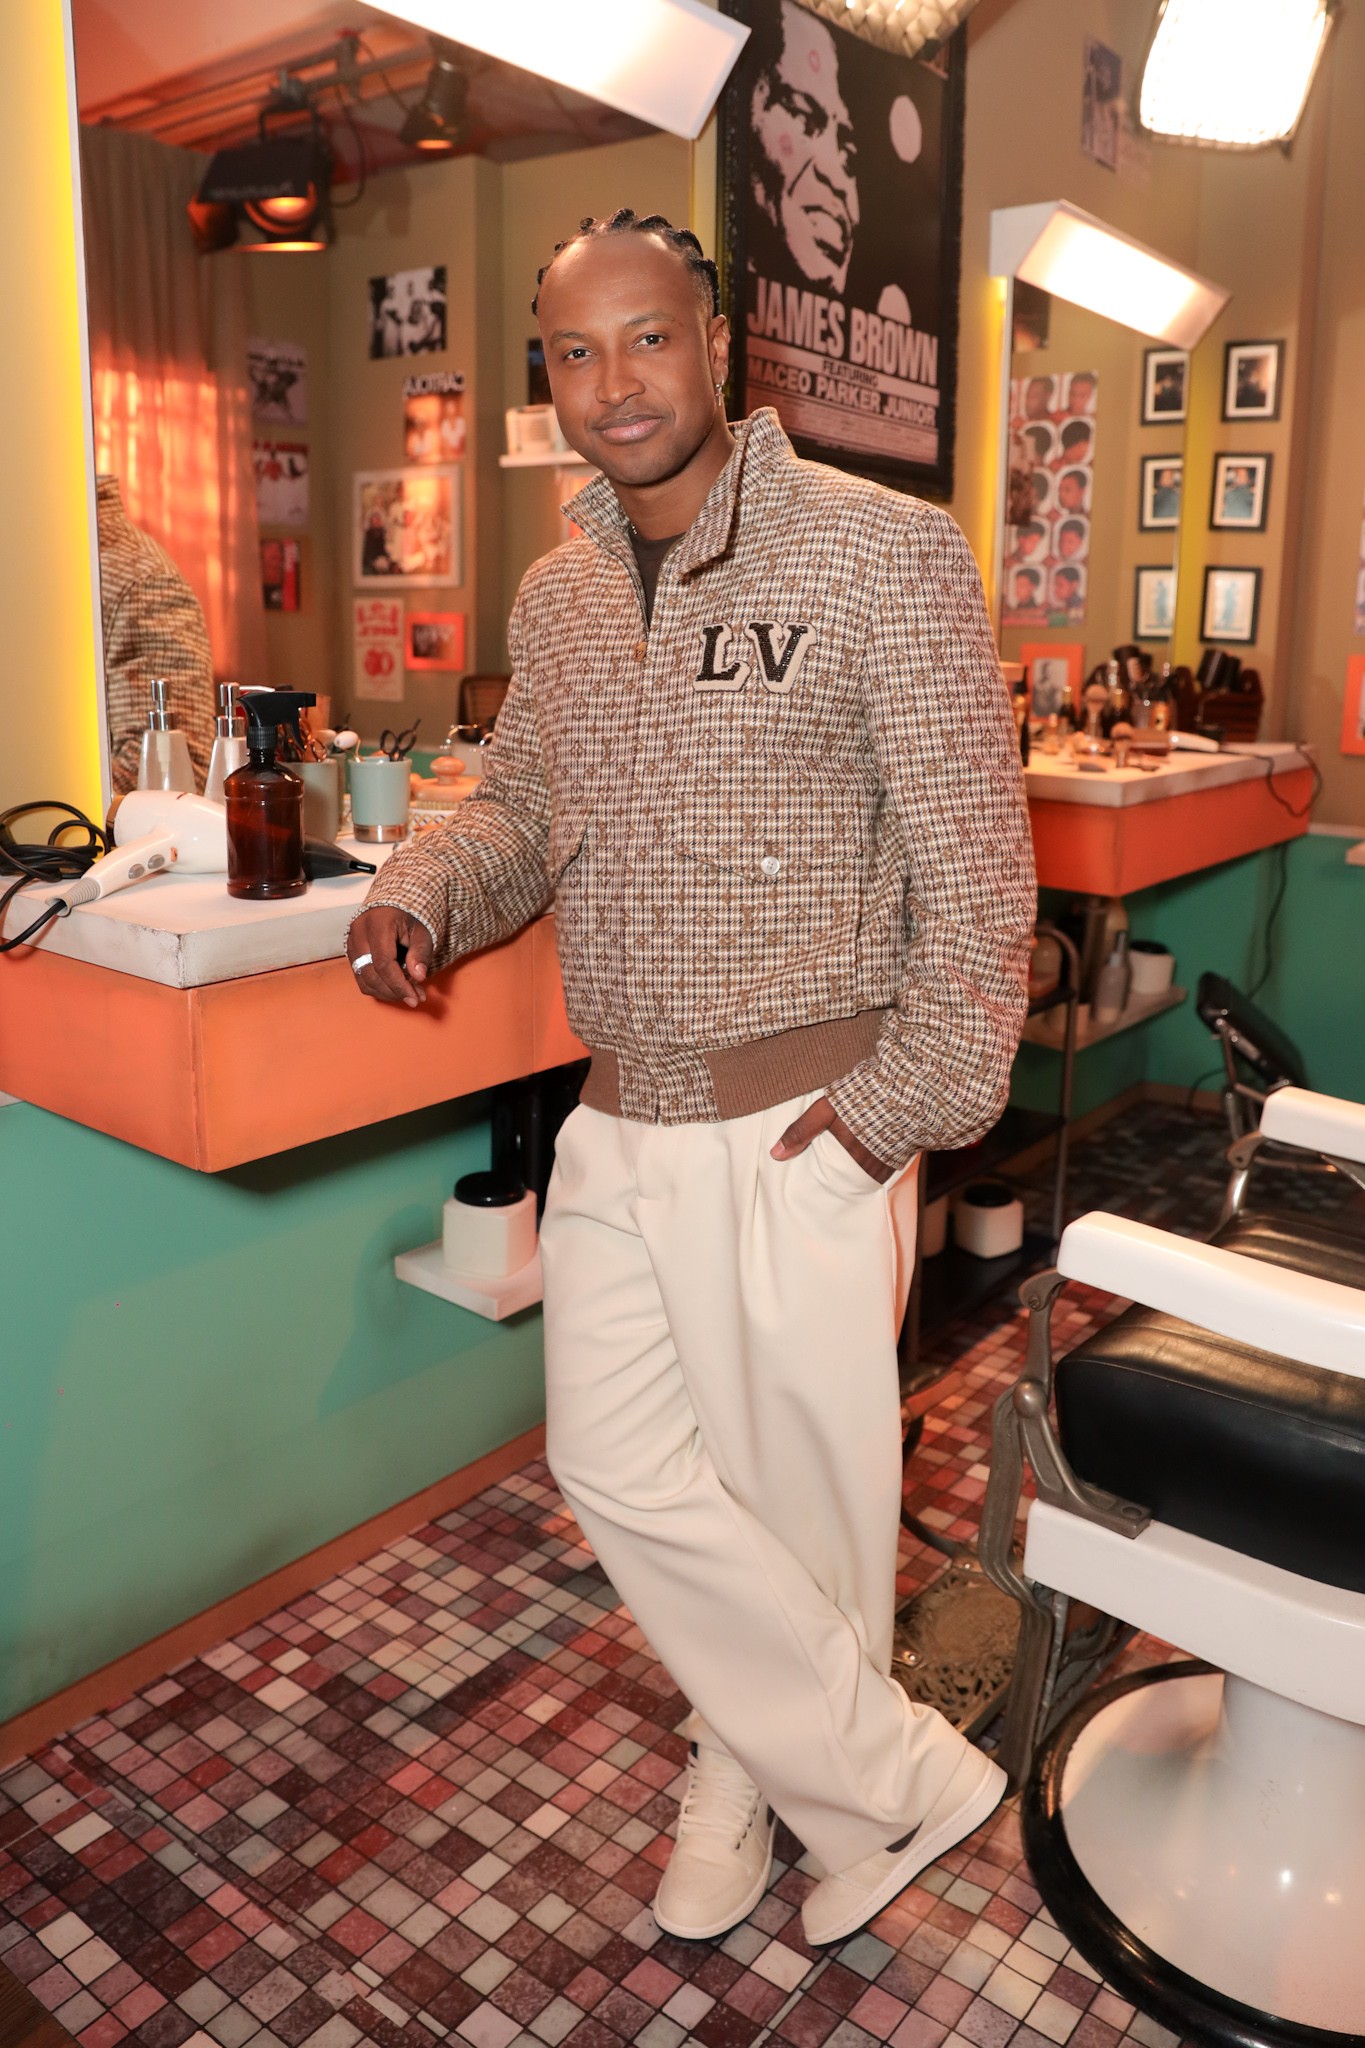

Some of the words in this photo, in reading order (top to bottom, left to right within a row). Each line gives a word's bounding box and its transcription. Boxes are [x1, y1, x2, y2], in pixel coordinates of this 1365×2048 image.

[747, 276, 846, 359] JAMES
[849, 306, 939, 386] BROWN
[747, 356, 812, 393] MACEO
[816, 376, 881, 413] PARKER
[884, 395, 937, 427] JUNIOR
[822, 360, 879, 387] FEATURING
[693, 621, 815, 691] LV
